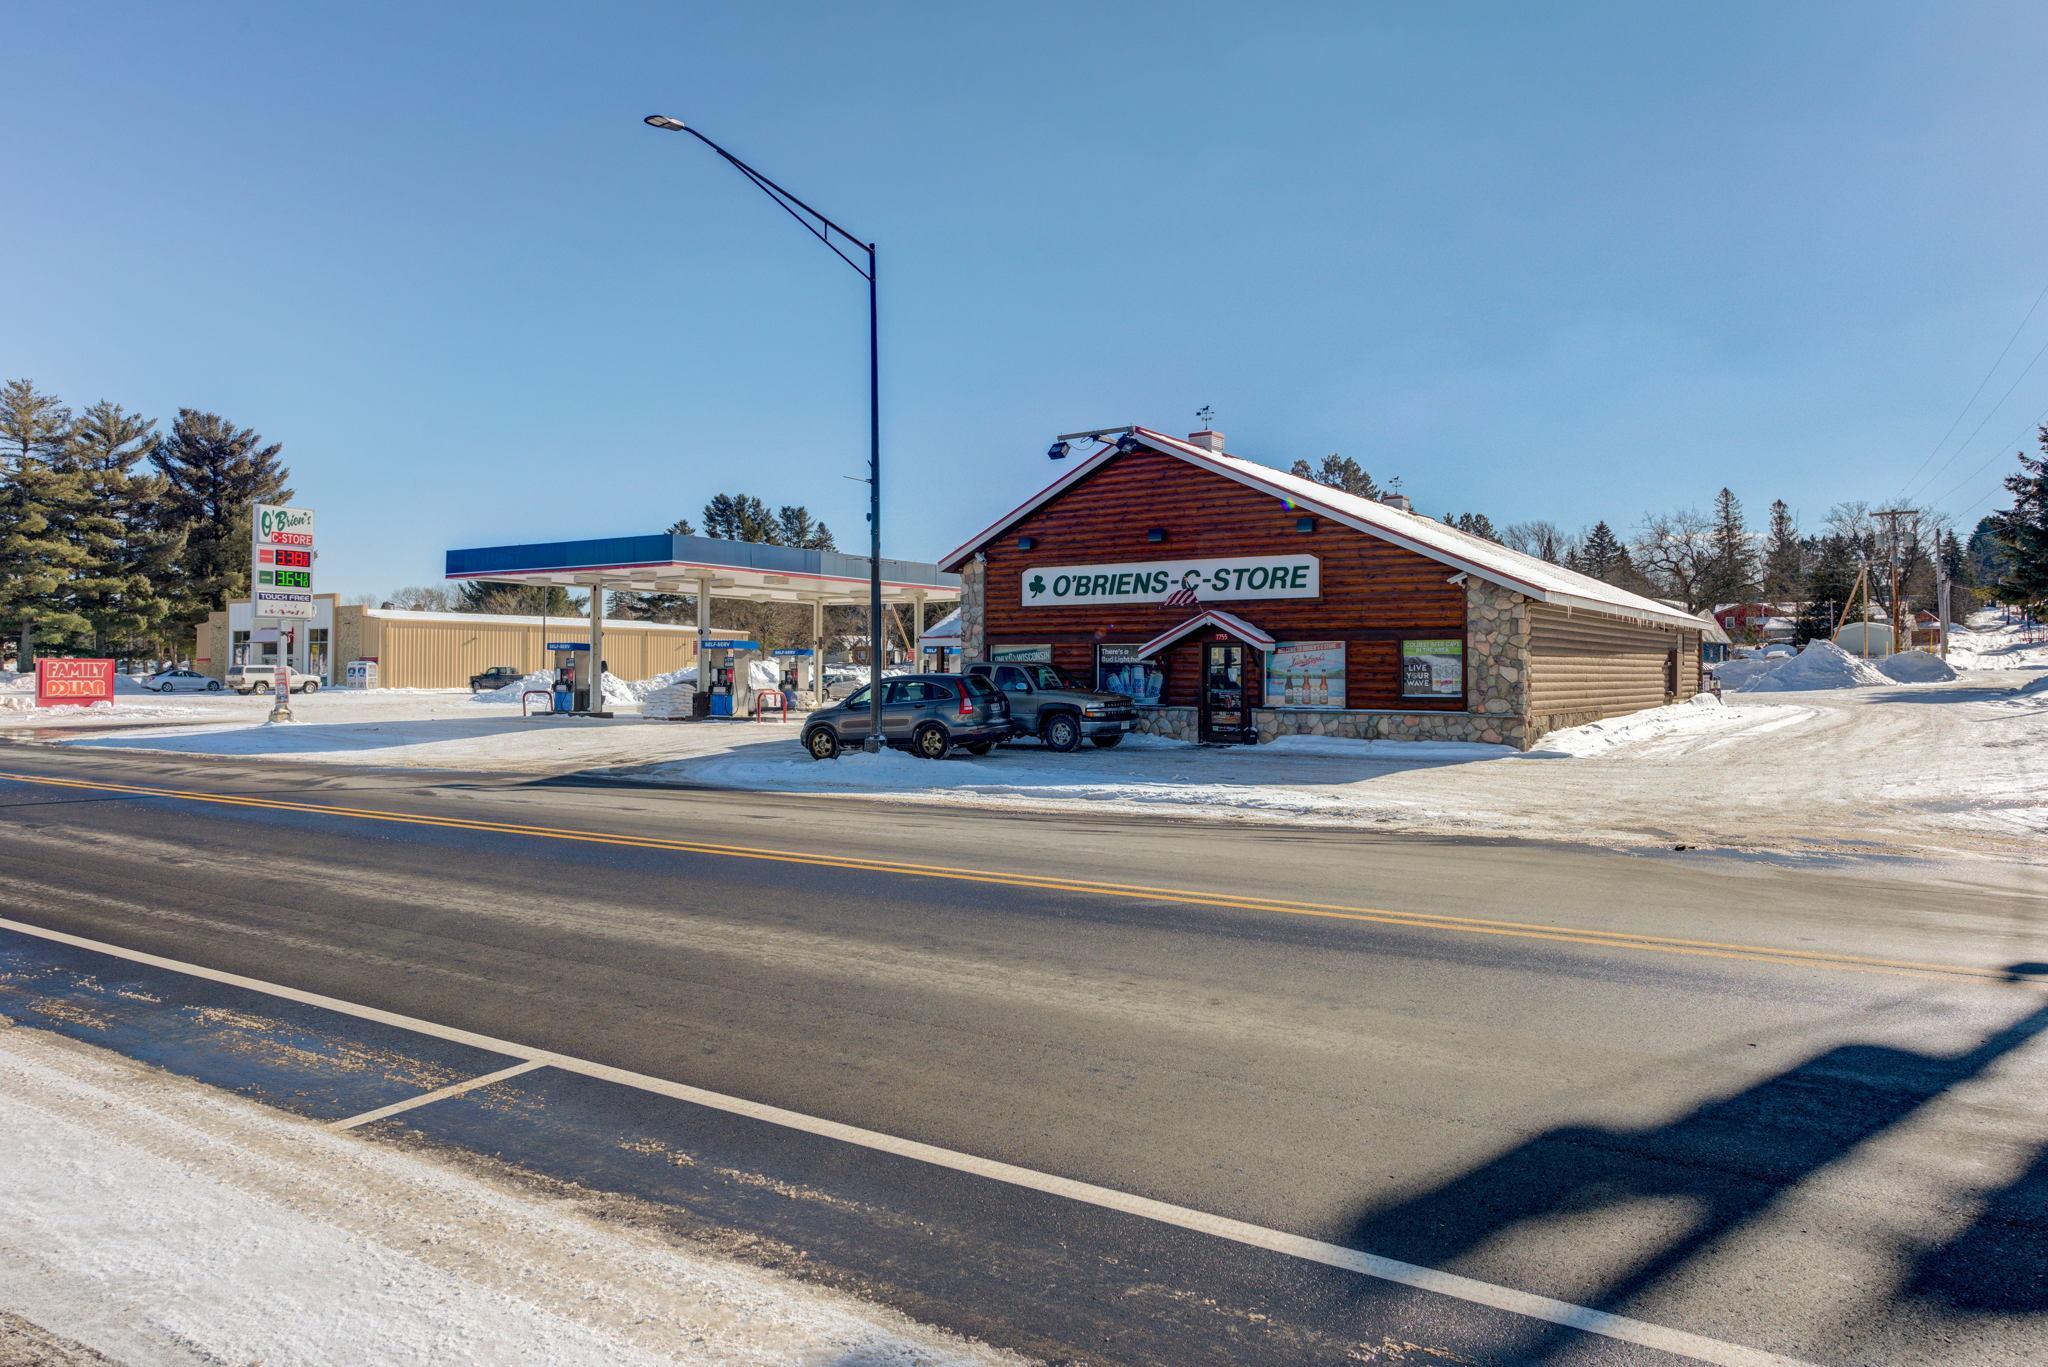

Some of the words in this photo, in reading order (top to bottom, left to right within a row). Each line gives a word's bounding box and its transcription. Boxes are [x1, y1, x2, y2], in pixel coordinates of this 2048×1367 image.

[272, 532, 312, 545] C-STORE
[261, 593, 288, 601] TOUCH
[1016, 649, 1049, 662] WISCONSIN
[1114, 655, 1130, 664] Light
[47, 662, 108, 678] FAMILY
[1406, 672, 1429, 680] YOUR
[47, 680, 105, 697] DOLLAR
